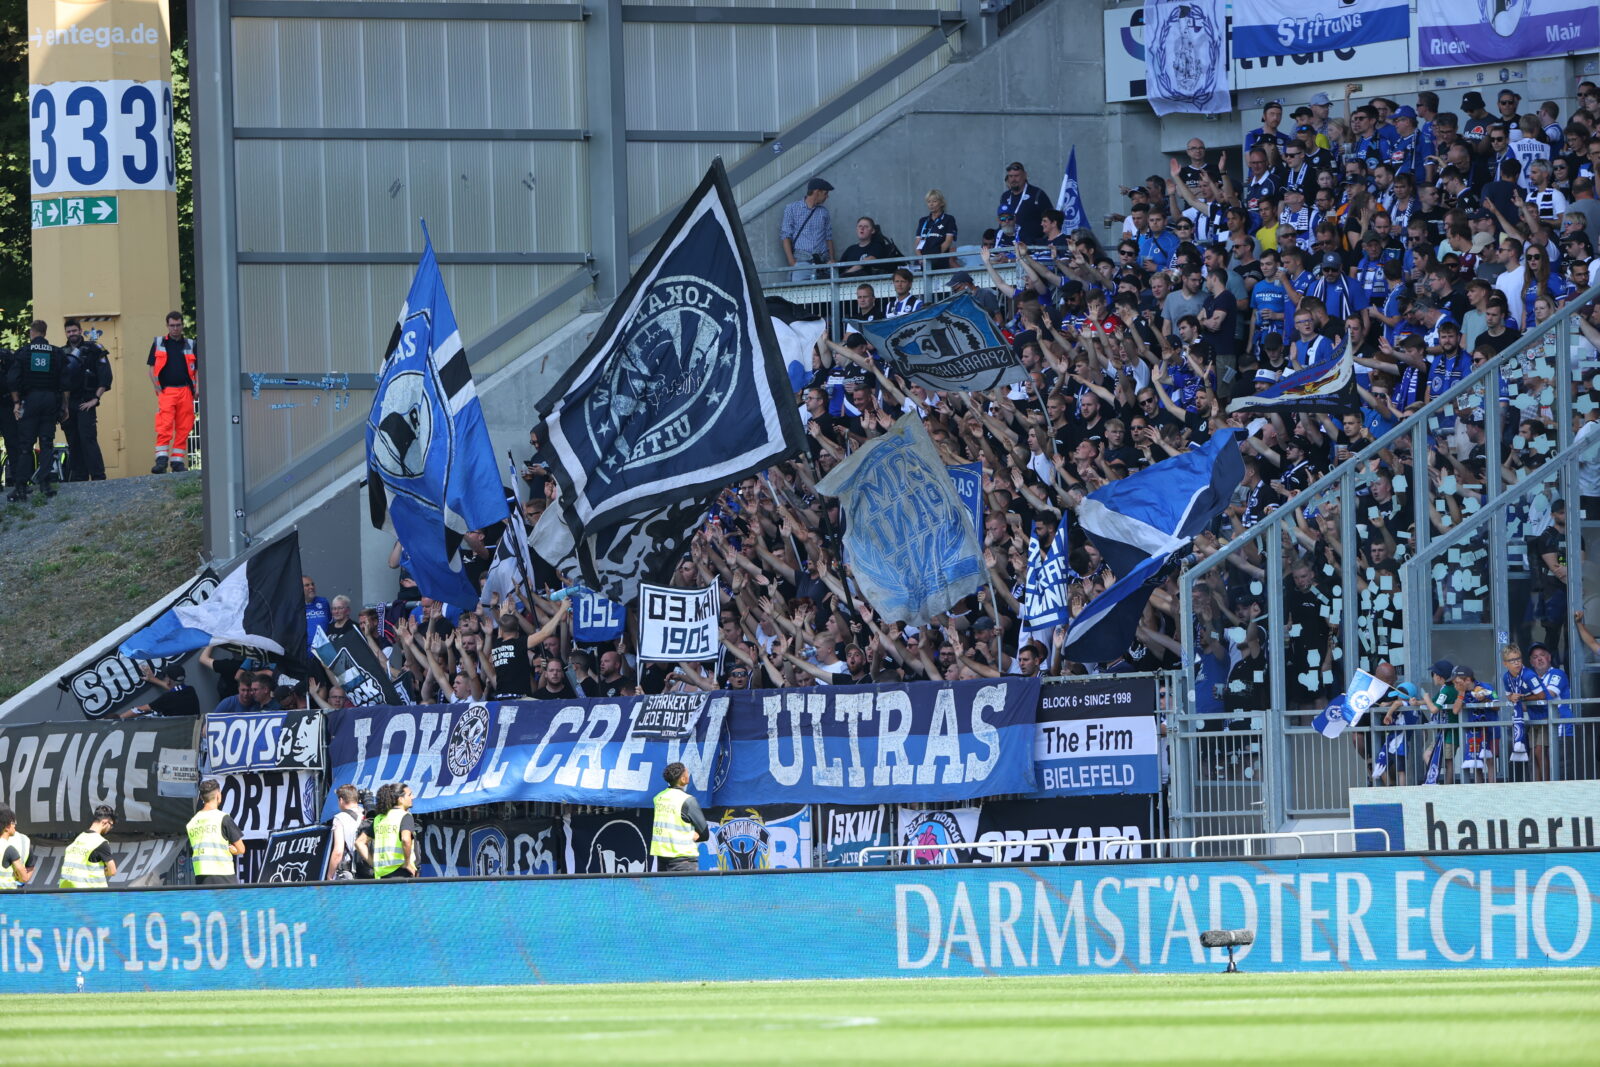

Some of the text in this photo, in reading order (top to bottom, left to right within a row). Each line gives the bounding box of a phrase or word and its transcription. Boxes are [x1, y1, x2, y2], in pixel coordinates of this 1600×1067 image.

[46, 23, 159, 48] entega.de
[1430, 22, 1581, 55] Rhein- Main
[1517, 143, 1545, 152] BIELEFELD
[30, 344, 53, 352] POLIZEI
[34, 358, 46, 367] 38
[648, 588, 716, 623] 03.MAI
[660, 623, 710, 655] 1905
[1042, 696, 1071, 709] BLOCK
[1072, 695, 1078, 707] 6
[1084, 693, 1111, 706] SINCE
[1112, 692, 1132, 704] 1998
[207, 717, 283, 769] BOYS
[522, 696, 730, 792] CREW
[762, 683, 1007, 787] ULTRAS
[1042, 724, 1133, 754] The Firm
[1043, 764, 1135, 790] BIELEFELD
[841, 853, 869, 864] ULTRS
[894, 864, 1594, 970] DARMSTÄDTER ECHO
[0, 907, 317, 973] its vor 19.30 Uhr.
